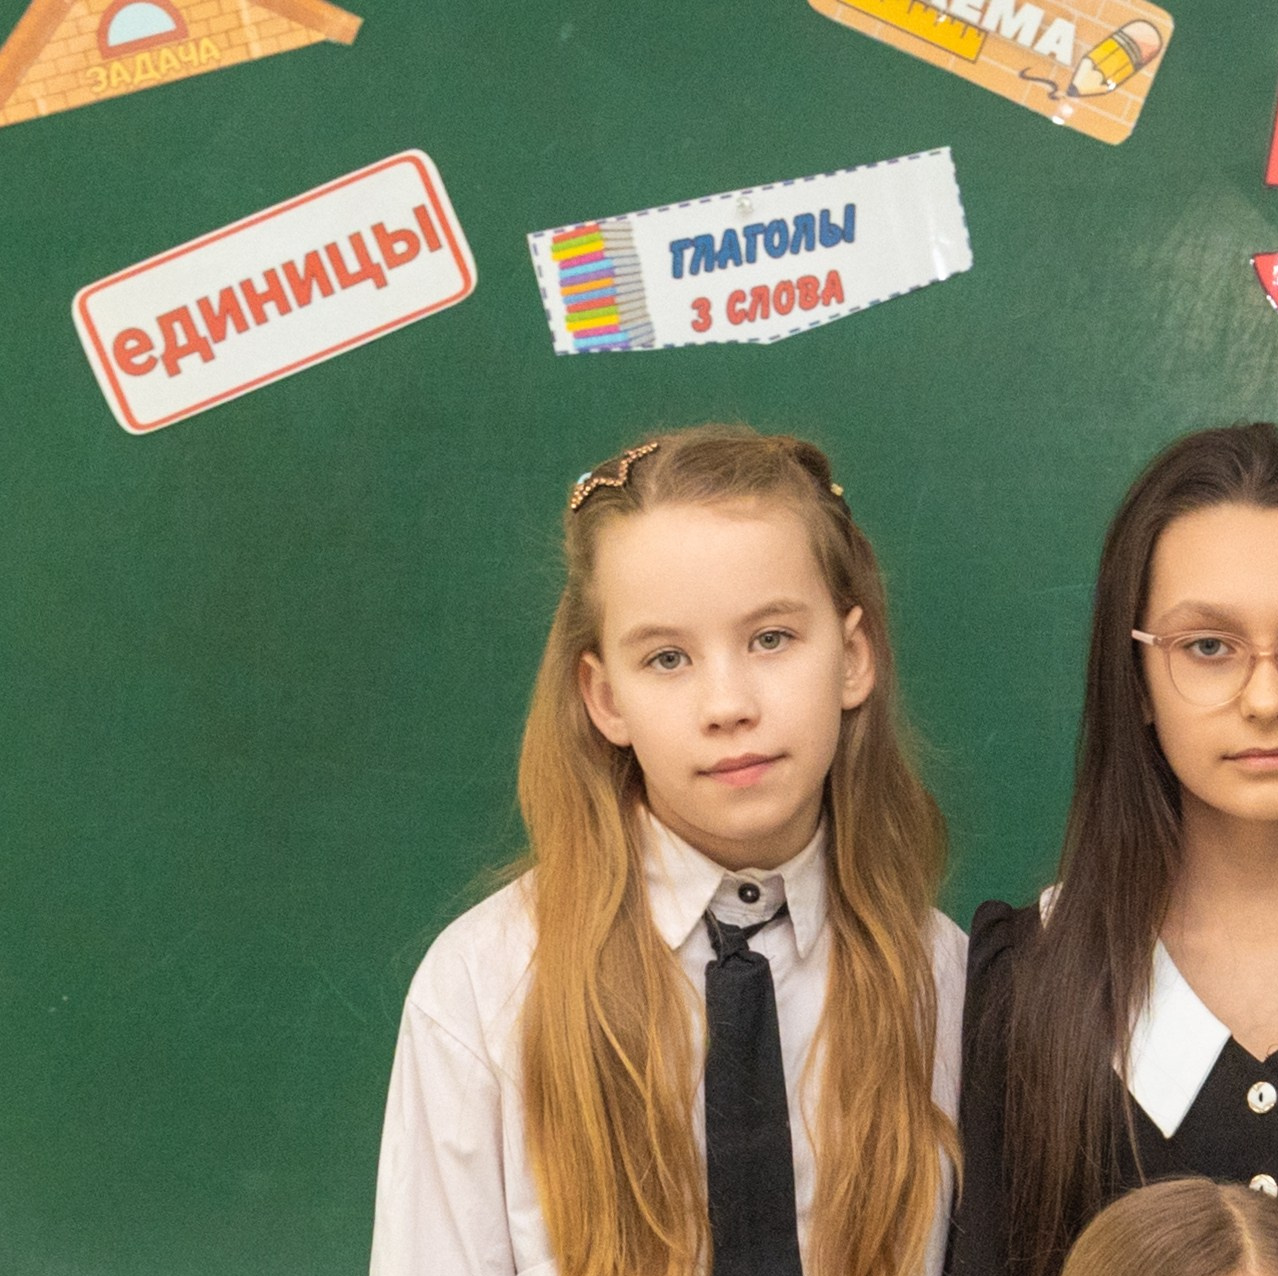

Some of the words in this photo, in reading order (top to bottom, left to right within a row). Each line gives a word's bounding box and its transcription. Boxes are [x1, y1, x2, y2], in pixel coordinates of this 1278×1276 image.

[86, 37, 221, 93] ЗАДАЧА
[669, 203, 856, 279] ГЛАГОЛЫ
[112, 203, 443, 377] единицы
[690, 296, 713, 333] 3
[726, 270, 845, 325] СЛОВА
